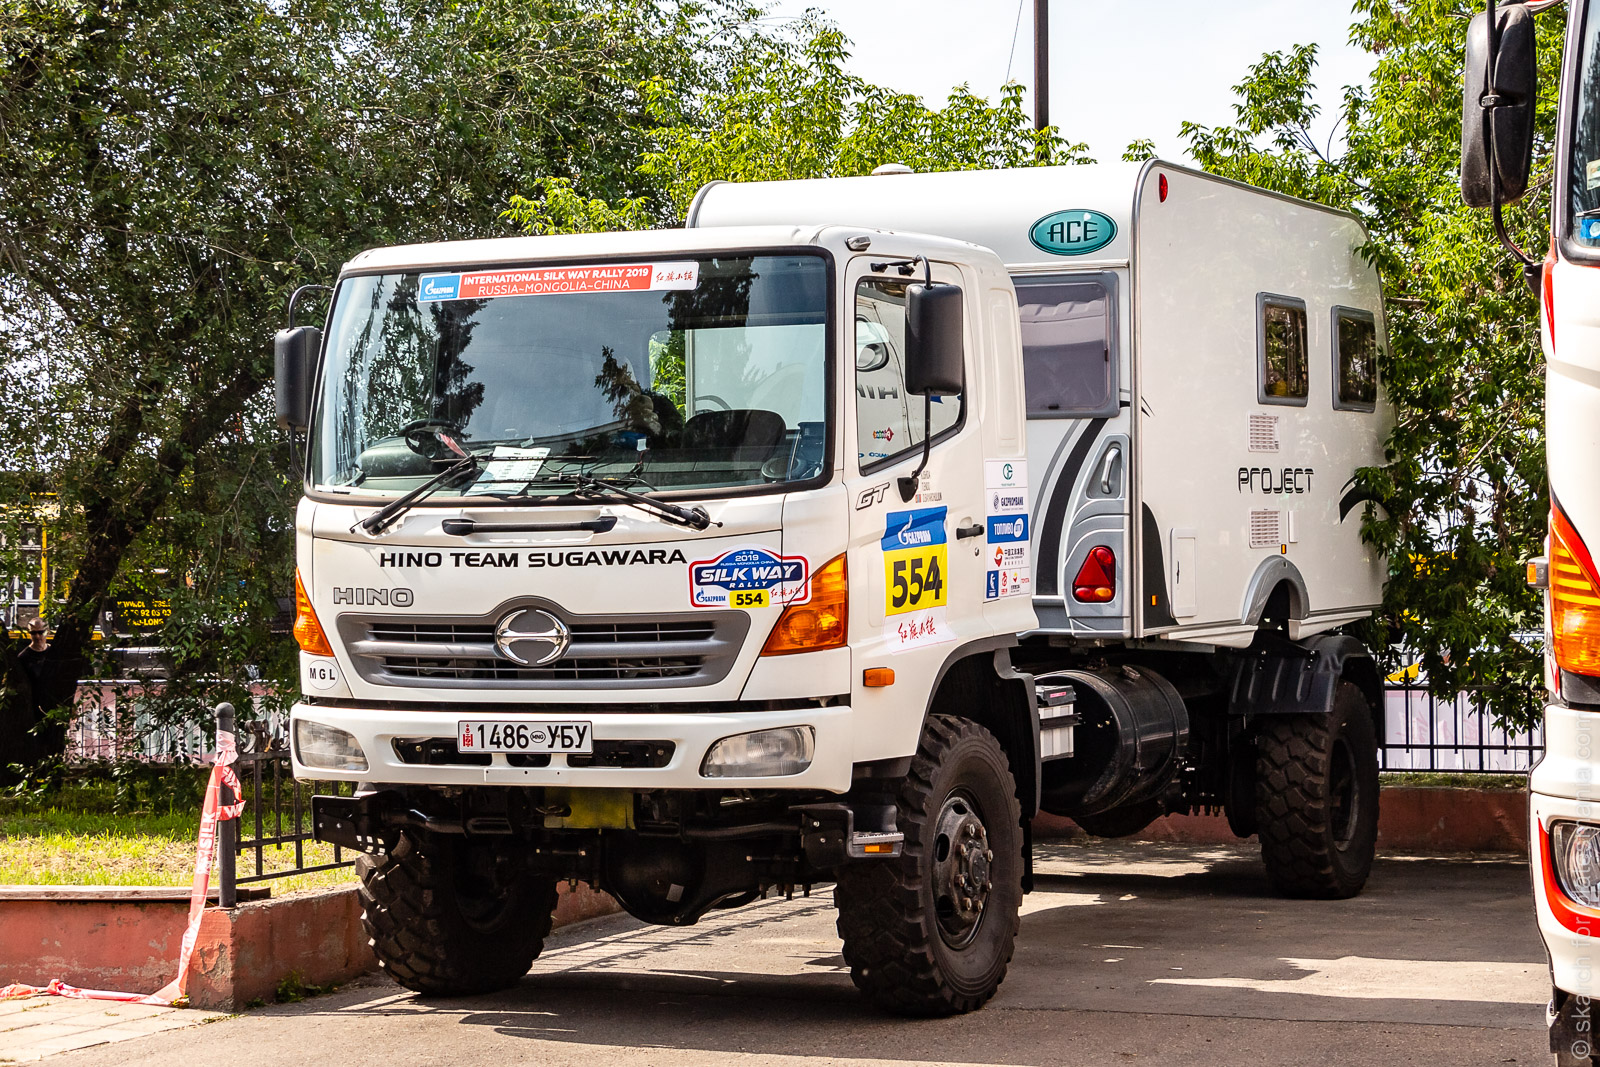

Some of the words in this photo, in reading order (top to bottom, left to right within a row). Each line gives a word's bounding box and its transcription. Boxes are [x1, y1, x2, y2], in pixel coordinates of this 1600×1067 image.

[1046, 220, 1098, 243] ACE
[464, 271, 541, 286] INTERNATIONAL
[543, 270, 565, 281] SILK
[567, 269, 591, 280] WAY
[592, 268, 625, 279] RALLY
[626, 267, 649, 278] 2019
[1238, 467, 1314, 494] PROJECT
[856, 482, 890, 510] GT
[907, 530, 932, 545] GAZPROM
[379, 552, 443, 568] HINO
[449, 552, 519, 568] TEAM
[527, 549, 688, 568] SUGAWARA
[735, 554, 759, 562] 2019
[699, 567, 749, 583] SILK
[751, 564, 798, 580] WAY
[892, 555, 943, 608] 554
[729, 580, 768, 589] RALLY
[333, 587, 414, 608] HINO
[735, 592, 764, 606] 554
[309, 667, 336, 681] MGL
[477, 723, 530, 749] 1486
[547, 725, 588, 749] УБУ
[200, 811, 216, 848] SILK
